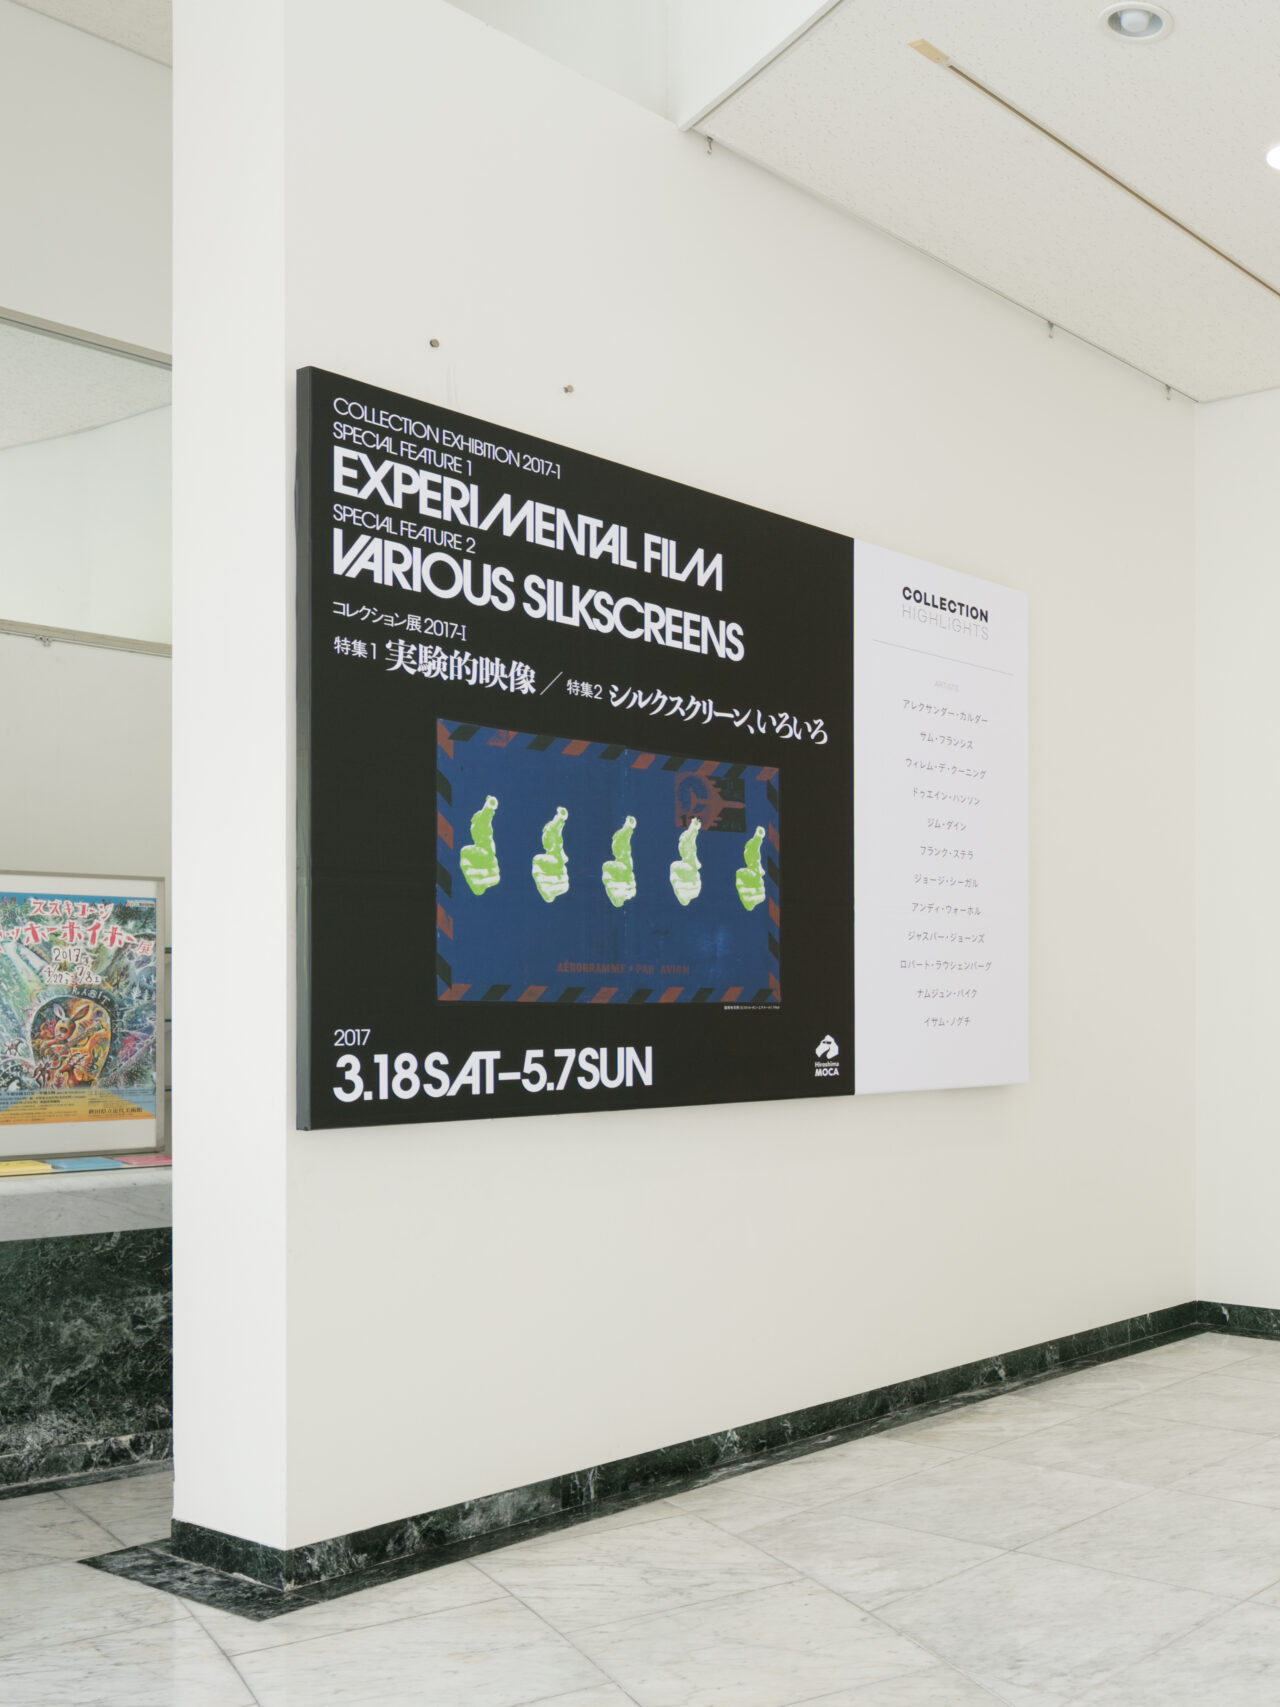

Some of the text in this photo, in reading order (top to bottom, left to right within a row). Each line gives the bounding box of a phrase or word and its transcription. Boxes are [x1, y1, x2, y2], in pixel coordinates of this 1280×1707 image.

[333, 397, 561, 480] COLLECTION EXHIBITION 2017-1
[333, 421, 473, 477] SPECIAL FEATURE 1
[332, 444, 724, 592] EXPERIMENTAL FILM
[333, 503, 476, 554] SPECIAL FEATURE 2
[332, 526, 745, 662] VARIOUS SILKSCREENS
[902, 586, 989, 623] COLLECTION
[902, 604, 989, 641] HIGHLIGHTS
[384, 638, 538, 696] 実験的映像
[608, 683, 829, 745] シルクスクリーン、いろいろ
[333, 1028, 371, 1048] 2017
[814, 1067, 840, 1077] MOCA
